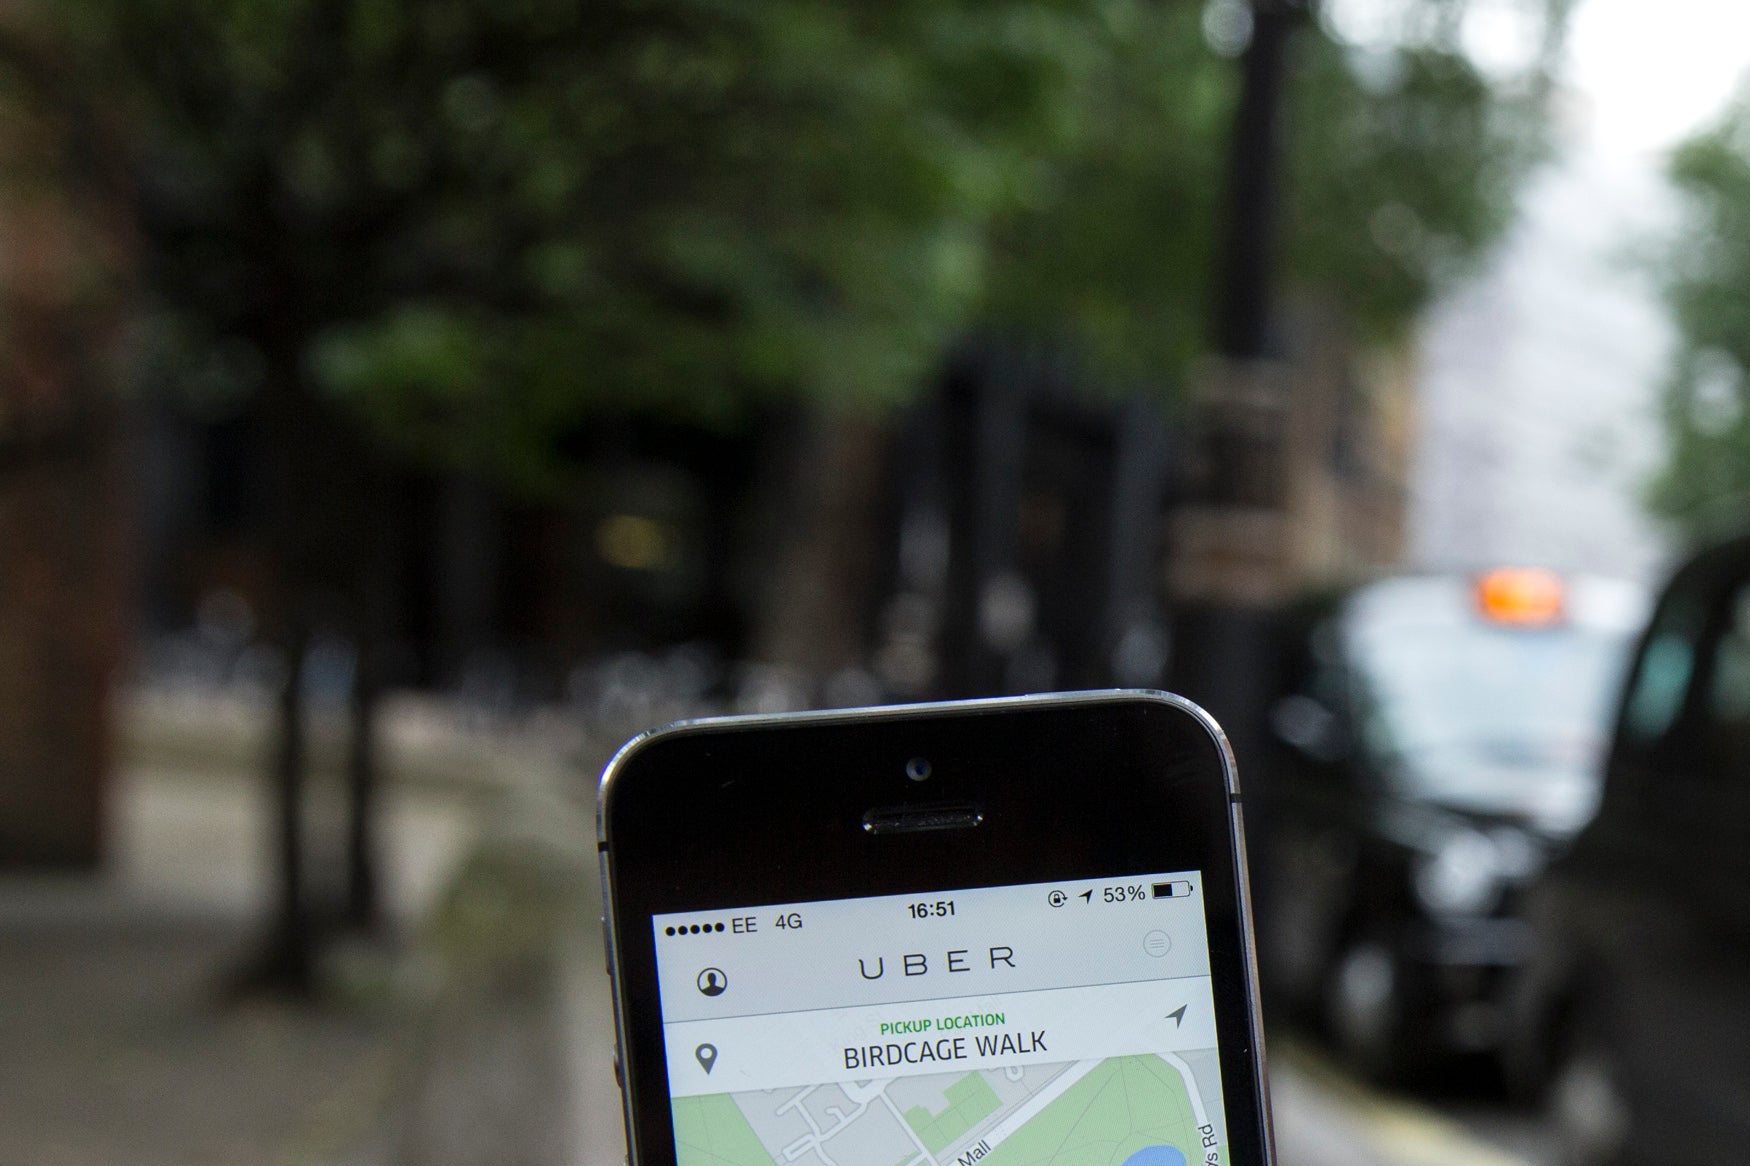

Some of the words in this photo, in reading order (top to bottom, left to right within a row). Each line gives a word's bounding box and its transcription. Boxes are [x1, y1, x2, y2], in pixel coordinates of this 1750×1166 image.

[1103, 884, 1146, 904] 53%
[907, 900, 957, 919] 16:51
[731, 916, 758, 934] EE
[774, 912, 803, 931] 4G
[858, 945, 1017, 980] UBER
[879, 1019, 932, 1036] PICKUP
[935, 1012, 1006, 1032] LOCATION
[843, 1039, 967, 1070] BIRDCAGE
[974, 1030, 1048, 1057] WALK
[1198, 1122, 1217, 1150] Rd
